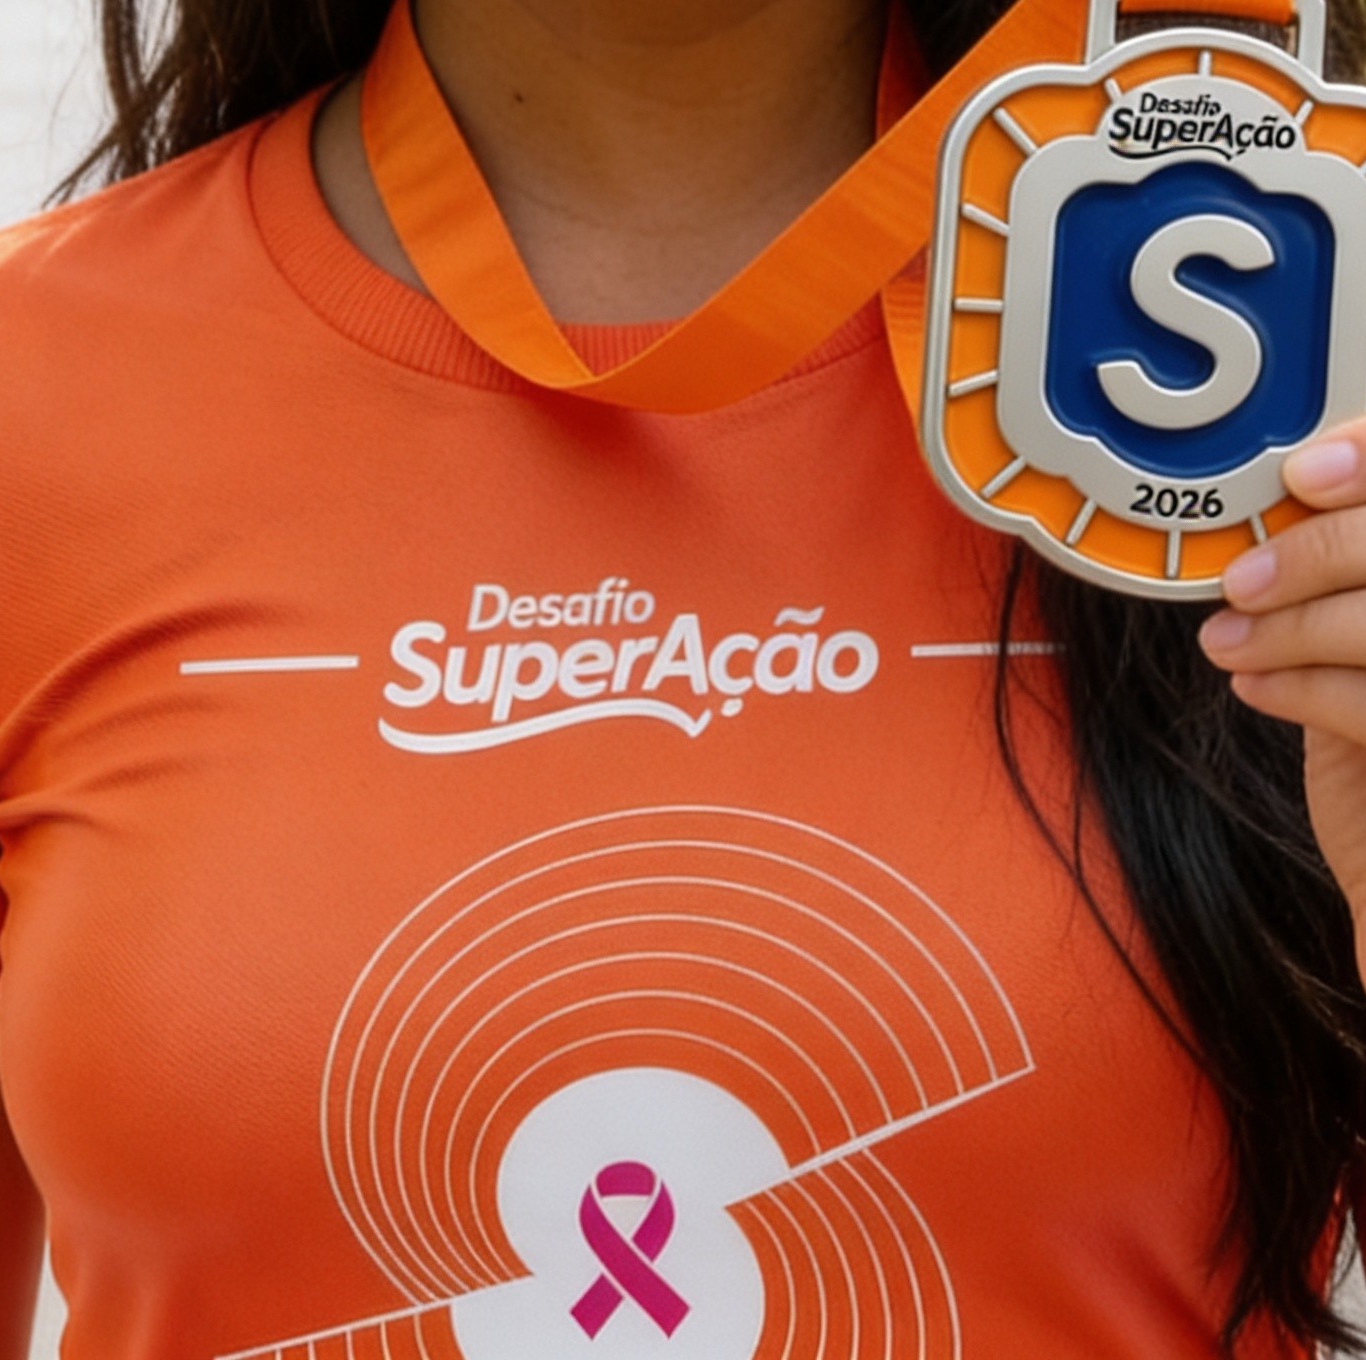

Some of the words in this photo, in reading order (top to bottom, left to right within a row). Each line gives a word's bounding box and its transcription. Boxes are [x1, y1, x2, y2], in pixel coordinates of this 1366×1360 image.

[1108, 107, 1296, 156] SuperAção
[1096, 213, 1276, 431] S
[1129, 483, 1224, 519] 2026
[466, 577, 656, 632] Desafio
[382, 605, 880, 723] SuperAção
